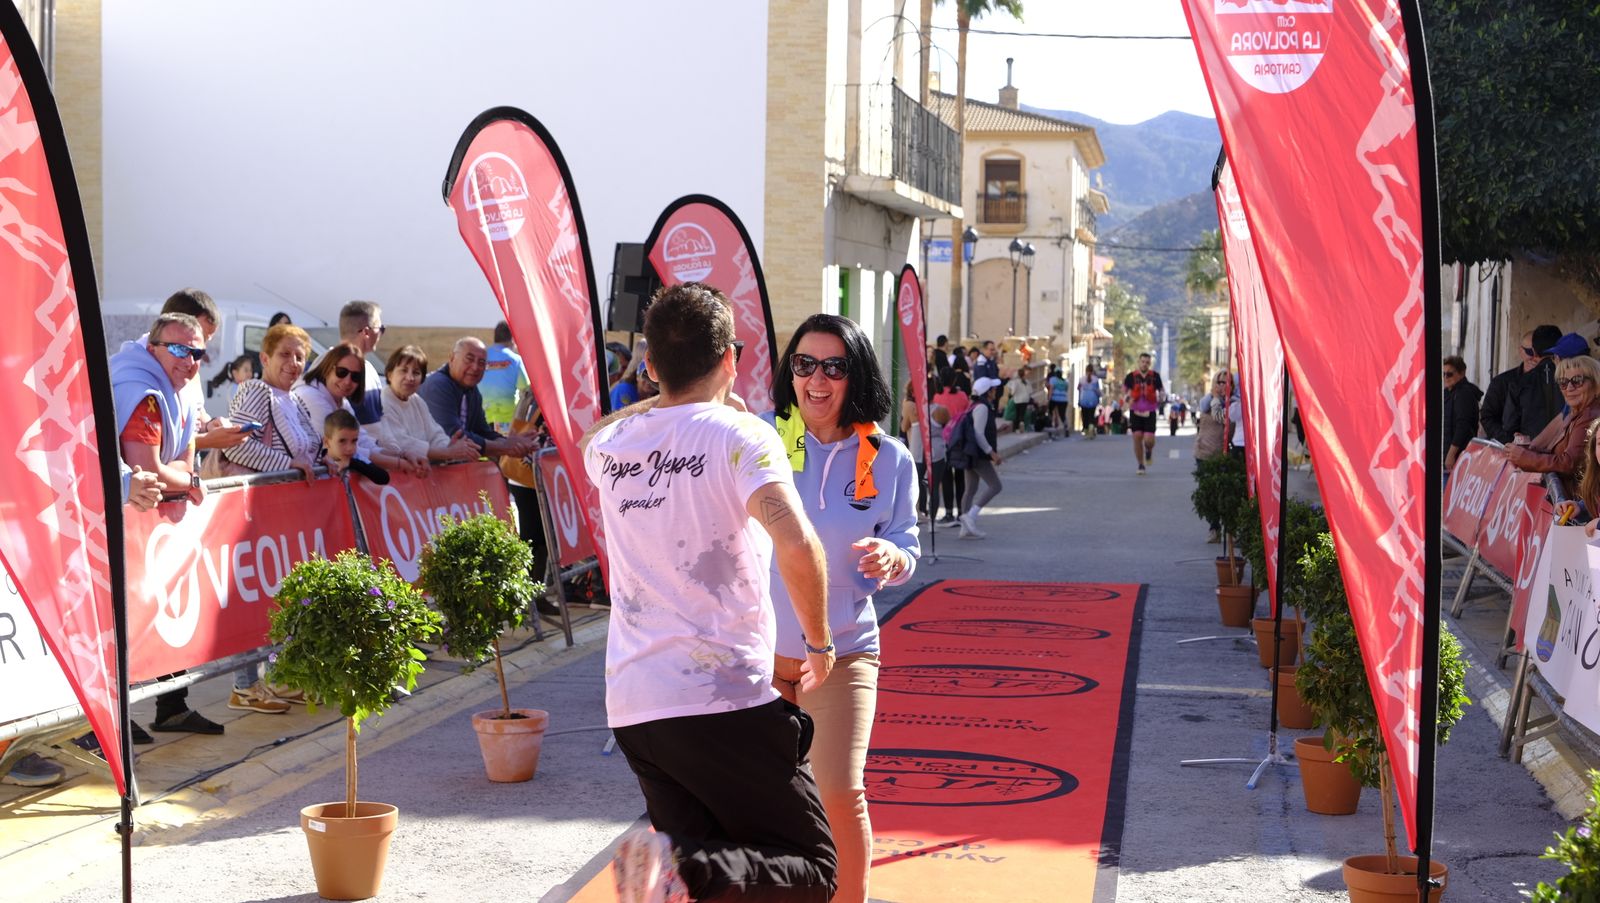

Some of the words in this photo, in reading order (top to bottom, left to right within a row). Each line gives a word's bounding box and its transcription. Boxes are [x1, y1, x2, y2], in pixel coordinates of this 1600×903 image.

[647, 449, 706, 488] Yepes
[618, 491, 666, 517] speaker
[874, 837, 924, 847] Ca
[937, 841, 985, 851] de
[872, 848, 1006, 863] Ayunta
